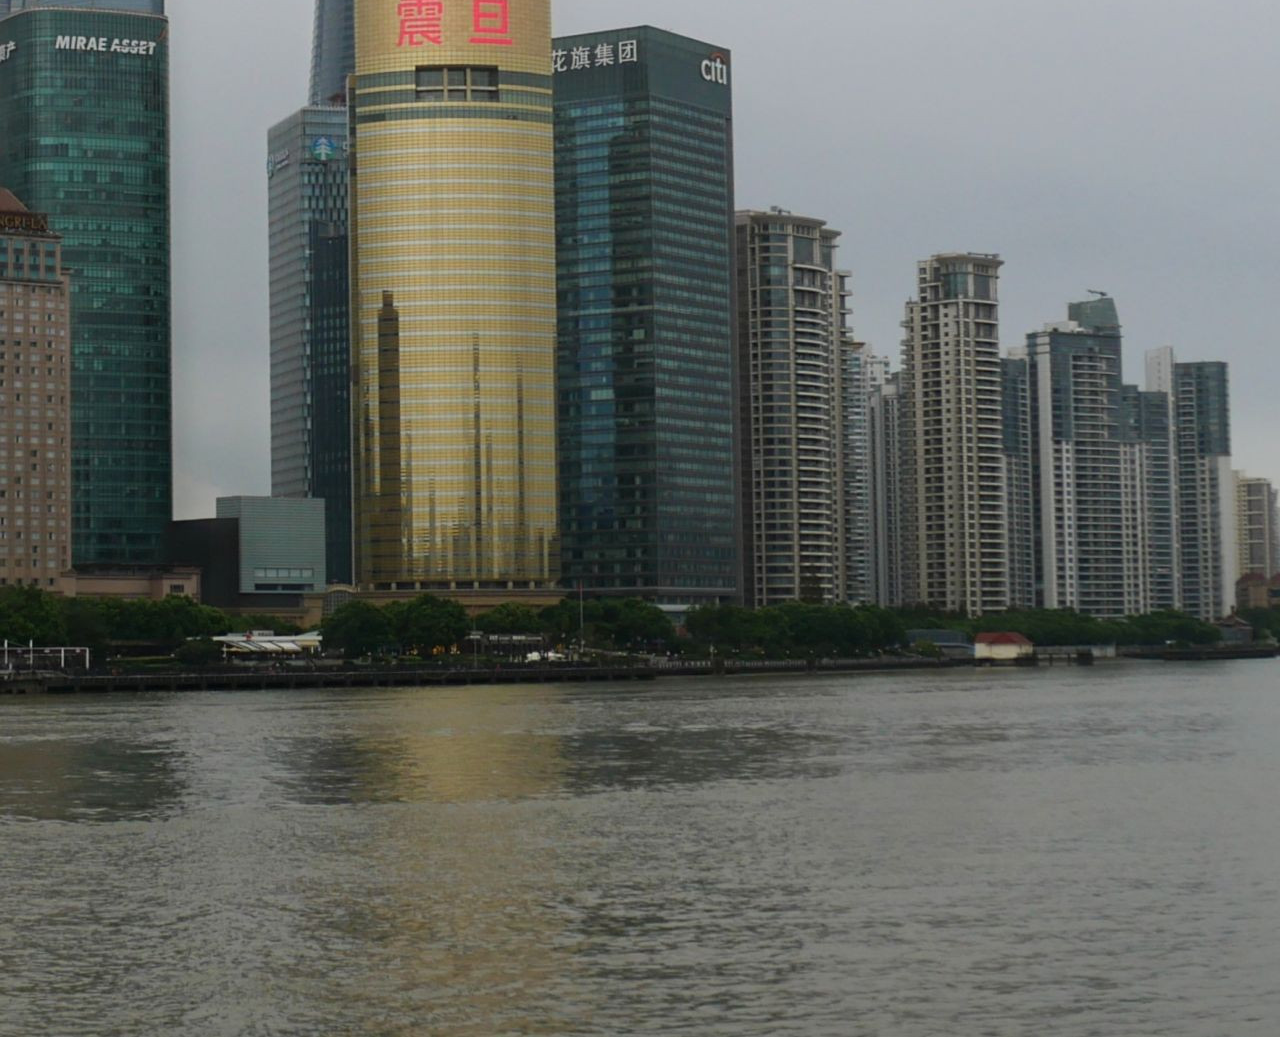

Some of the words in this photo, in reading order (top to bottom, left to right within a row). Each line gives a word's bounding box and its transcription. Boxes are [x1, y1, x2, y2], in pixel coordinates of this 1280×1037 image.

[55, 35, 107, 52] MIRAE
[111, 38, 156, 55] ASSET
[552, 40, 638, 72] 花旗集团
[701, 55, 728, 85] citi
